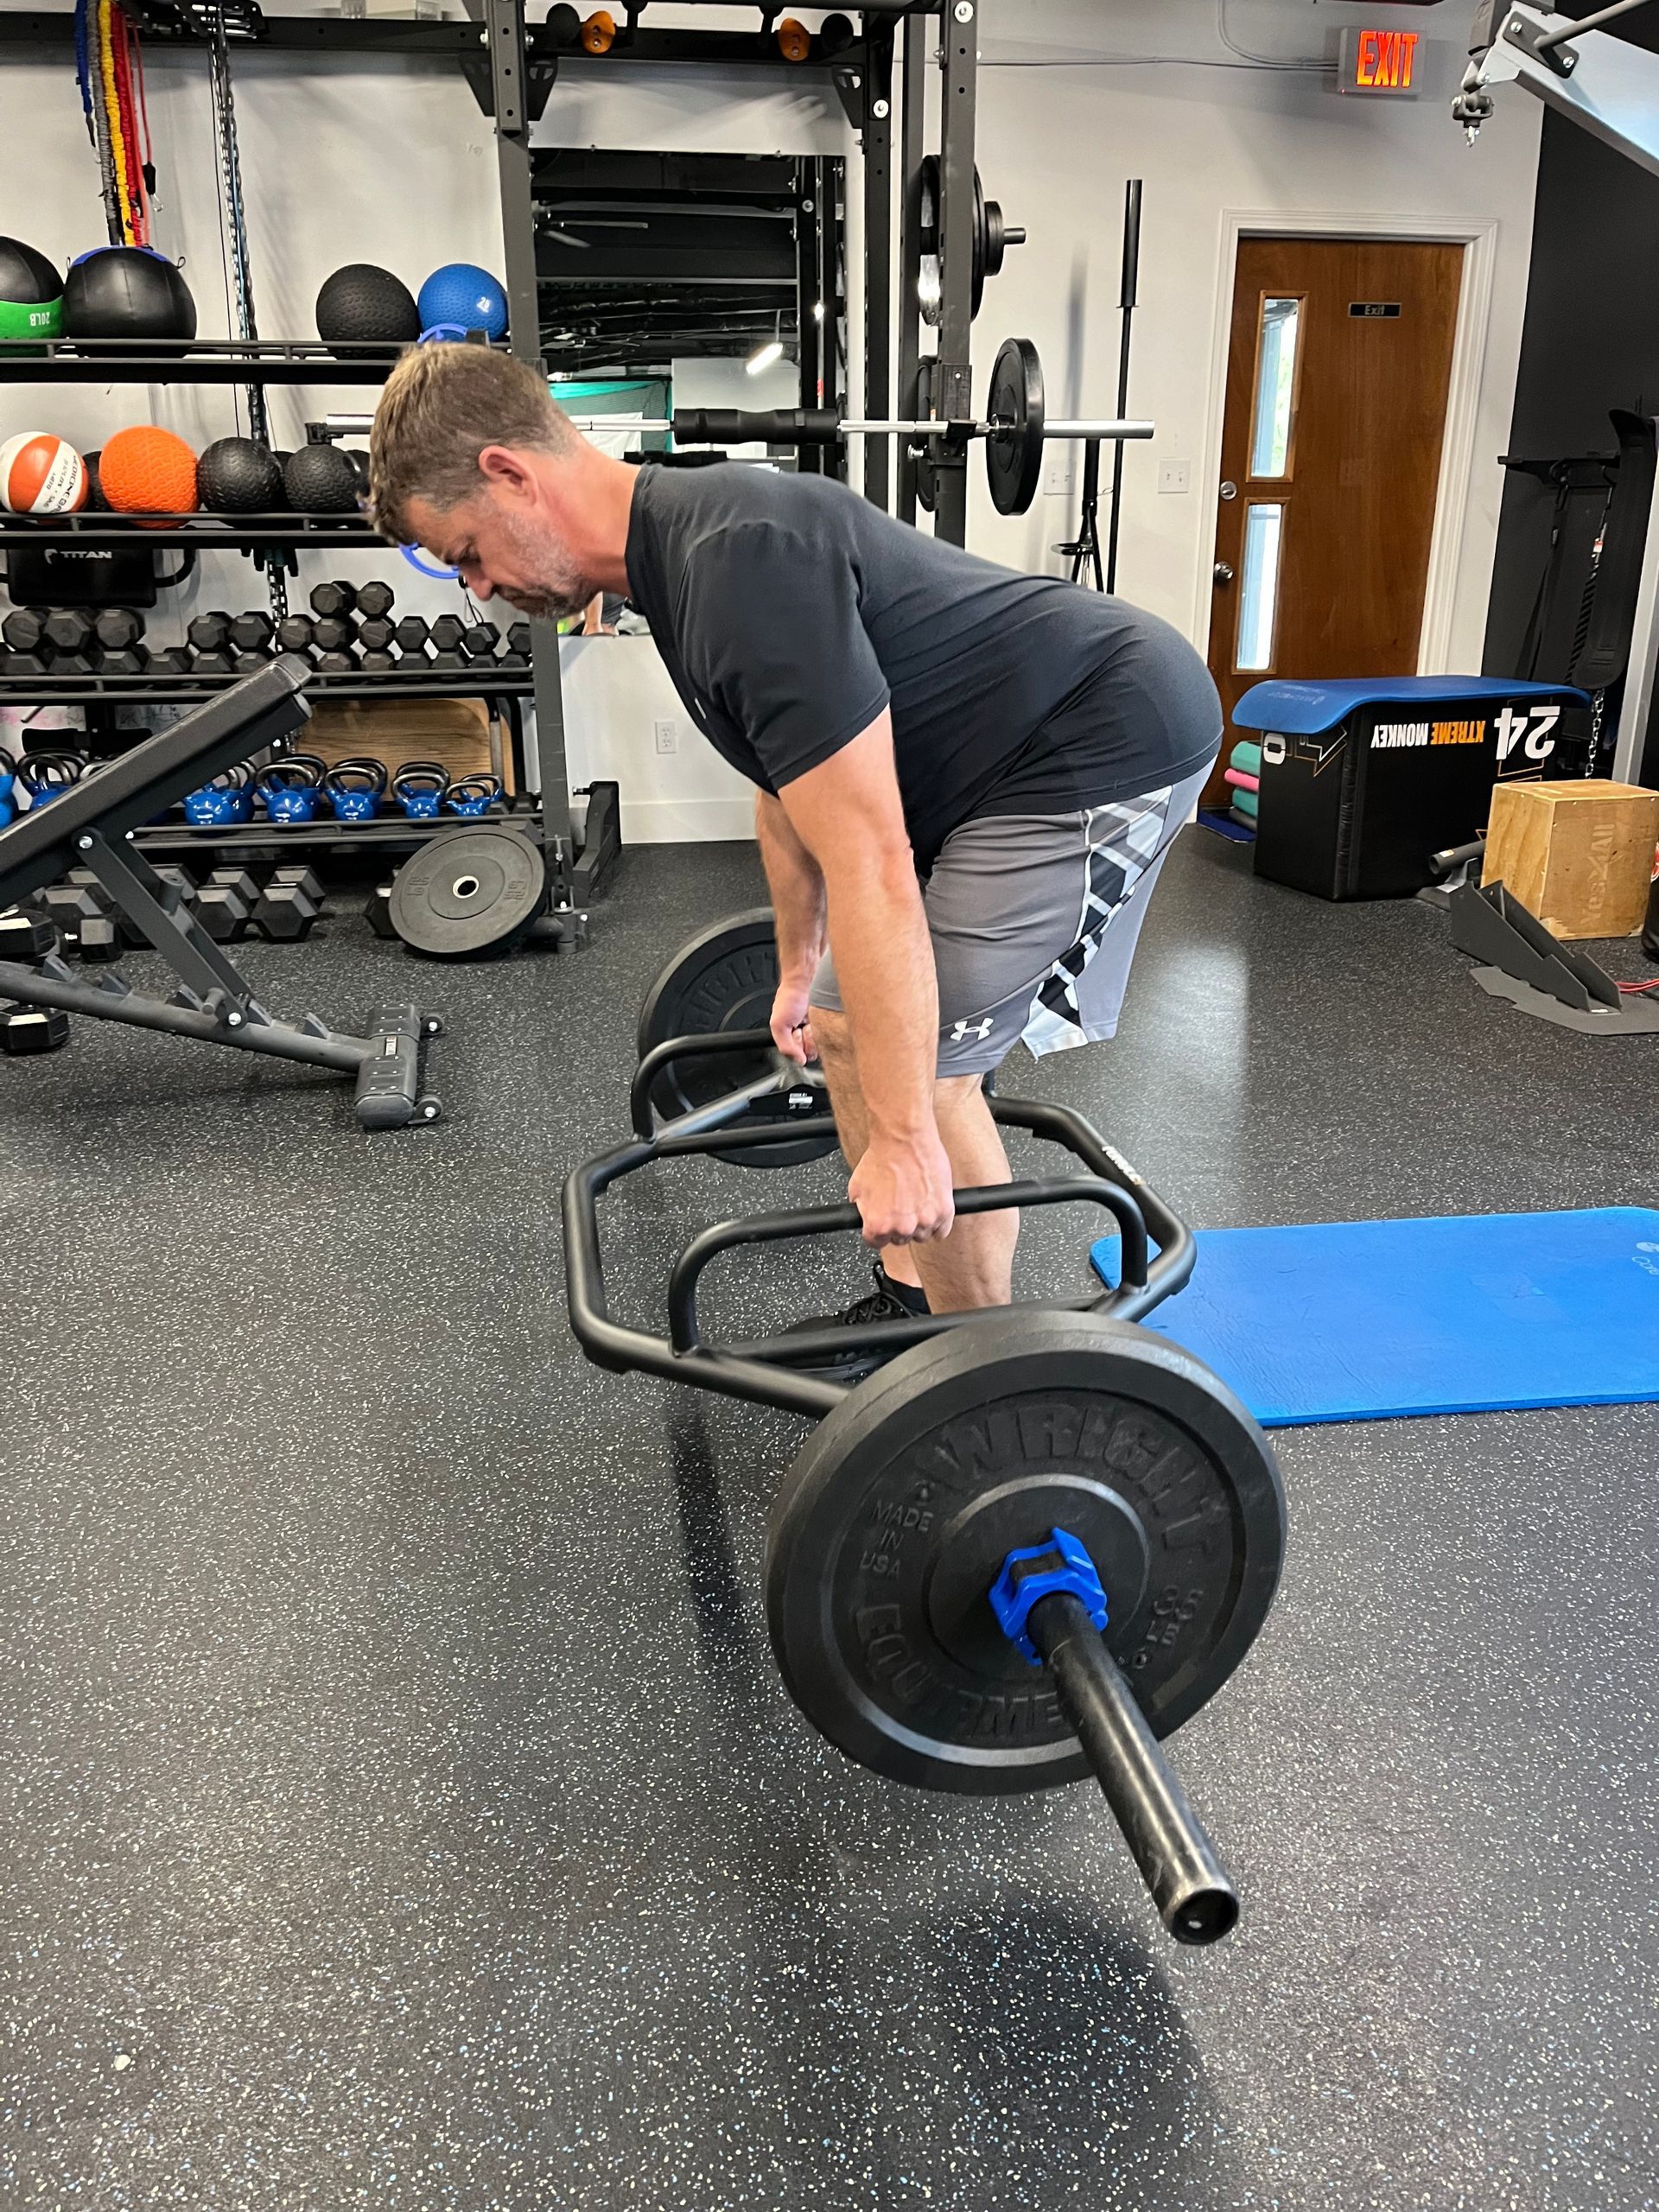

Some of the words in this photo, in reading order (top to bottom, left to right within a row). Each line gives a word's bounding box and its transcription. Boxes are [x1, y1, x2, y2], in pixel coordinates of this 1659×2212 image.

[1357, 30, 1418, 87] EXIT
[1364, 304, 1385, 315] Exit
[60, 550, 112, 559] TITAN
[1370, 722, 1429, 748] MONKEY
[1430, 720, 1486, 745] XTREME
[1494, 706, 1560, 760] 24
[916, 1404, 1227, 1551] WRIGHT
[872, 1500, 933, 1533] MADE
[880, 1529, 904, 1554] IN
[860, 1549, 900, 1580] USA
